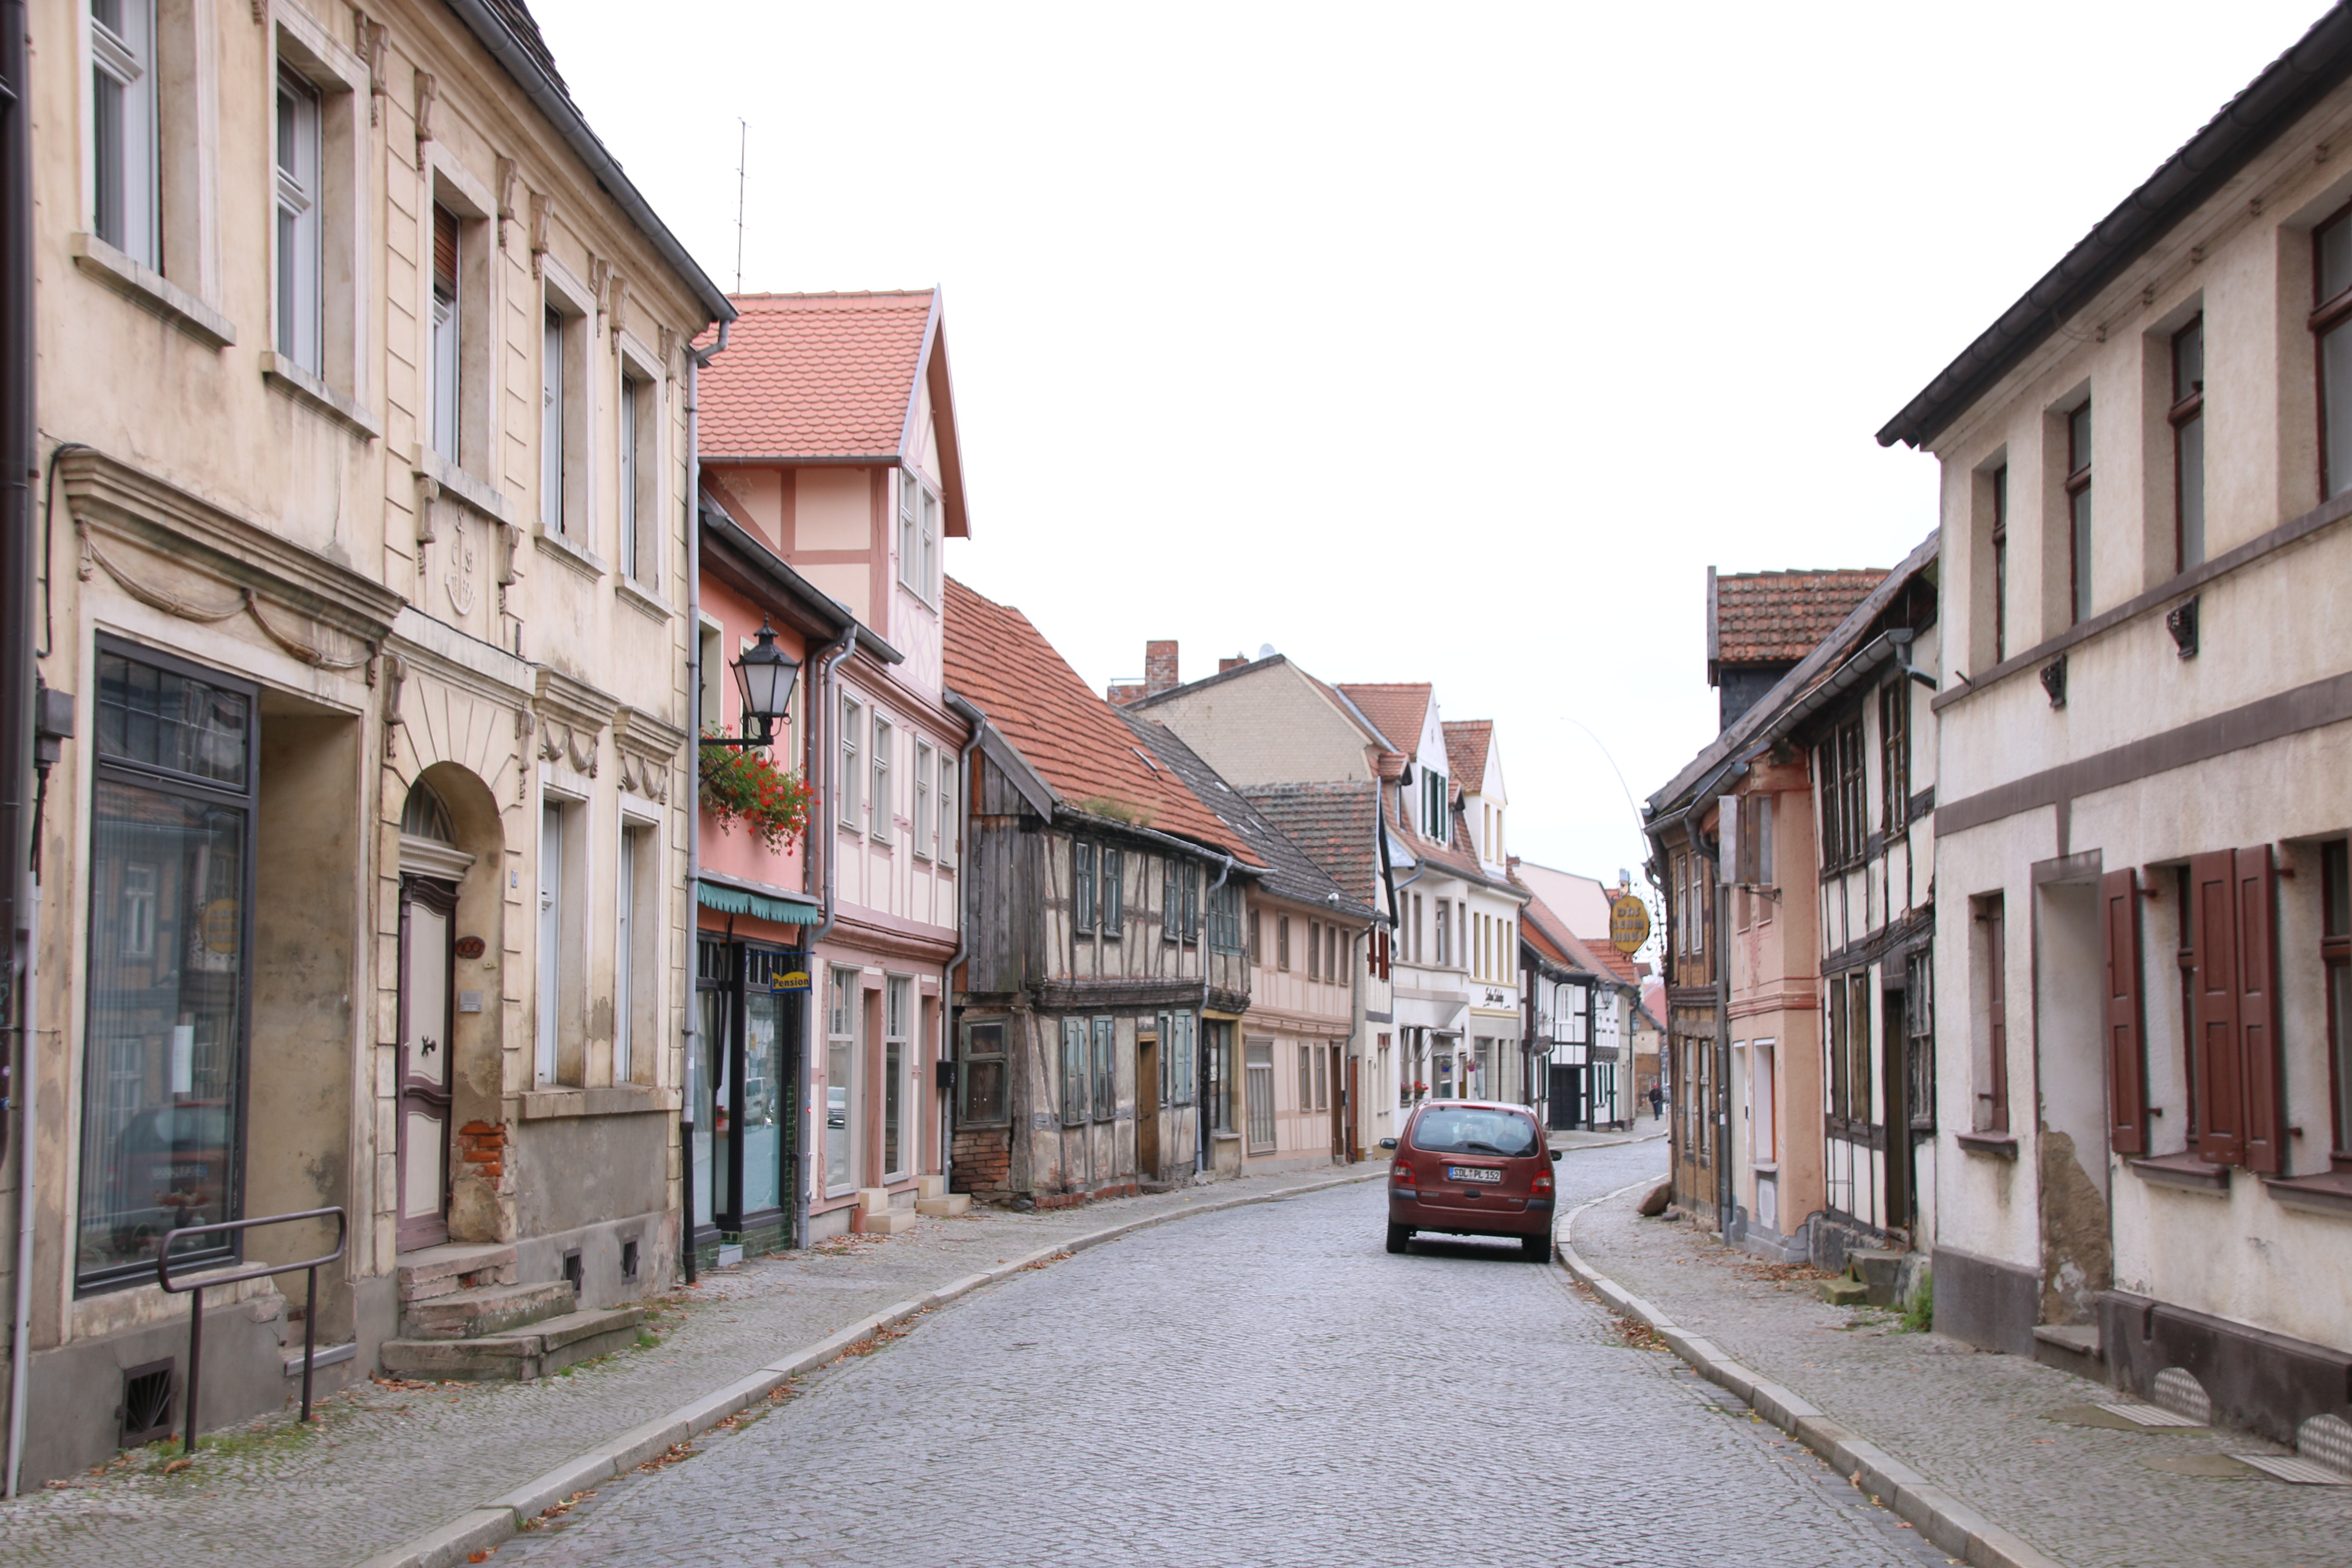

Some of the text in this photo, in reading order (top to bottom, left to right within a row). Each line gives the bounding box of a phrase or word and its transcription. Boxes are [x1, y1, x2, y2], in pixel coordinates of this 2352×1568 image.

[1617, 906, 1640, 917] DAS
[1613, 919, 1644, 929] LEHM
[1614, 932, 1644, 942] HAUS
[773, 977, 809, 987] Pension
[1454, 1168, 1500, 1180] SDL PL 152
